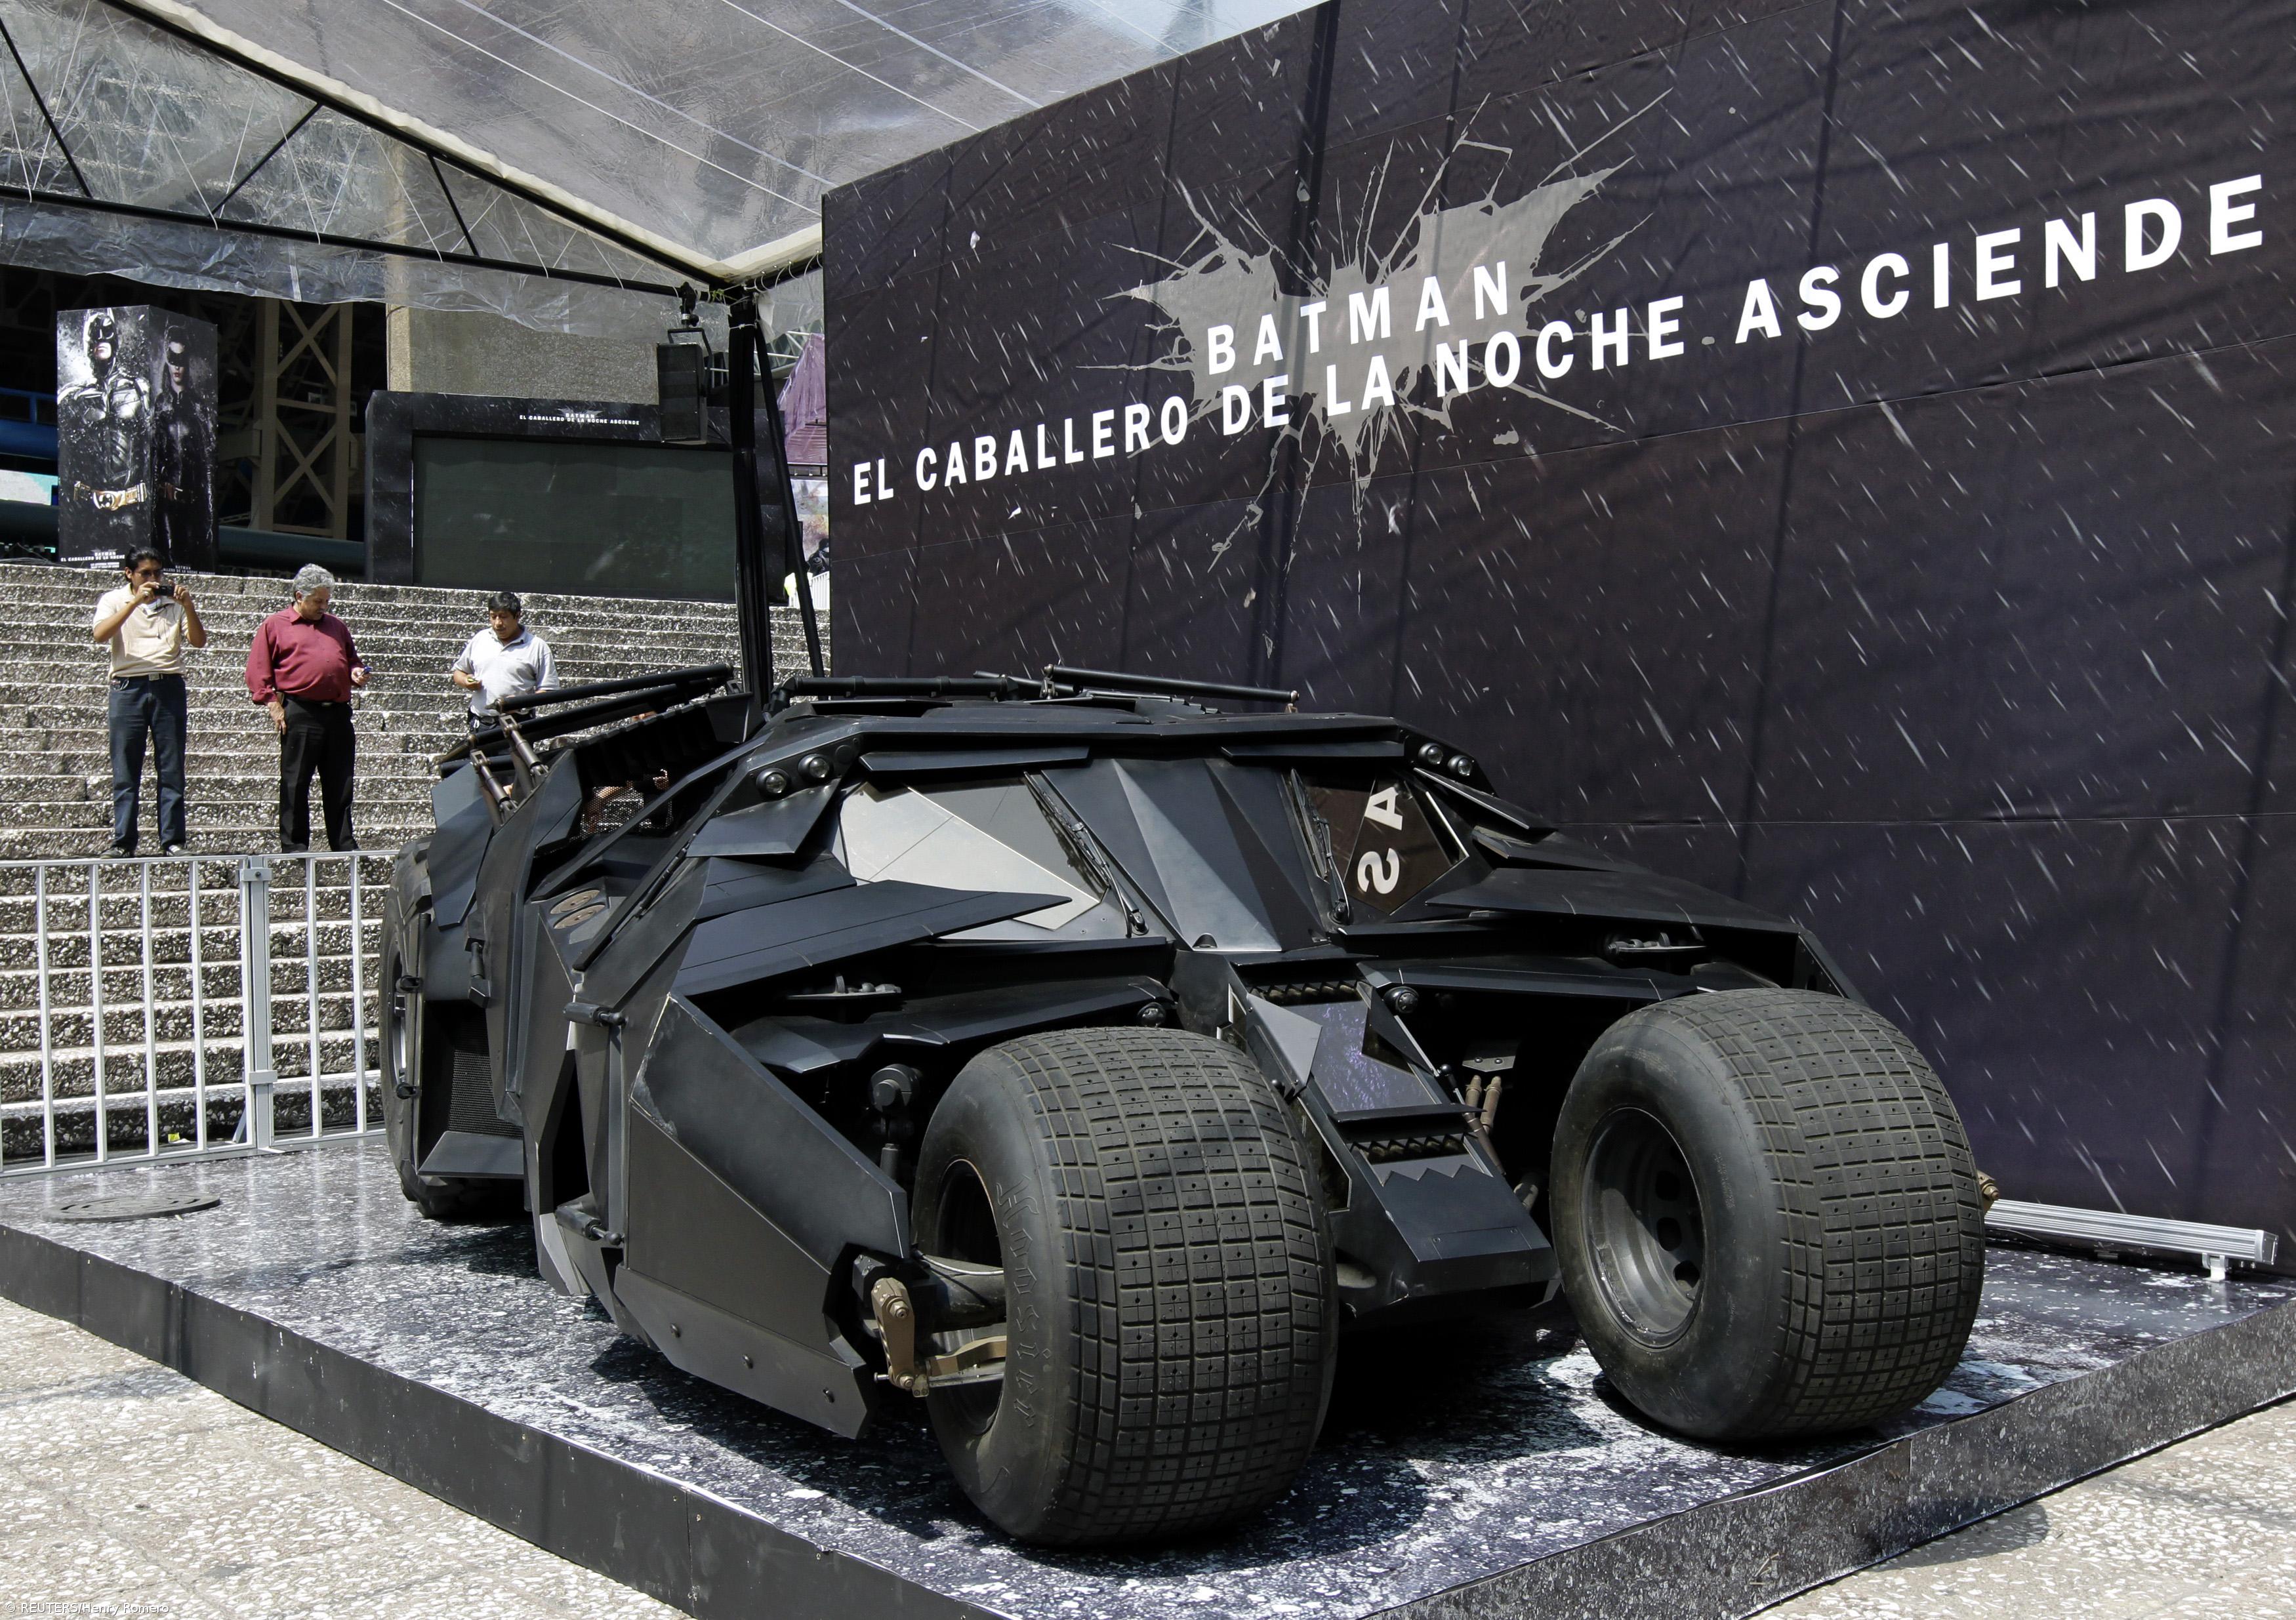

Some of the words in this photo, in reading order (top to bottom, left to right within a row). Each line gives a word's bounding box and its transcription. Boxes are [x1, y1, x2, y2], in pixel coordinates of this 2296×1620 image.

[853, 458, 894, 505] EL
[916, 396, 1187, 491] CABALLERO
[1223, 375, 1289, 435] DE
[1326, 355, 1395, 417] LA
[1436, 296, 1684, 397] NOCHE
[1735, 174, 2263, 344] ASCIENDE
[1208, 261, 1507, 375] BATMAN
